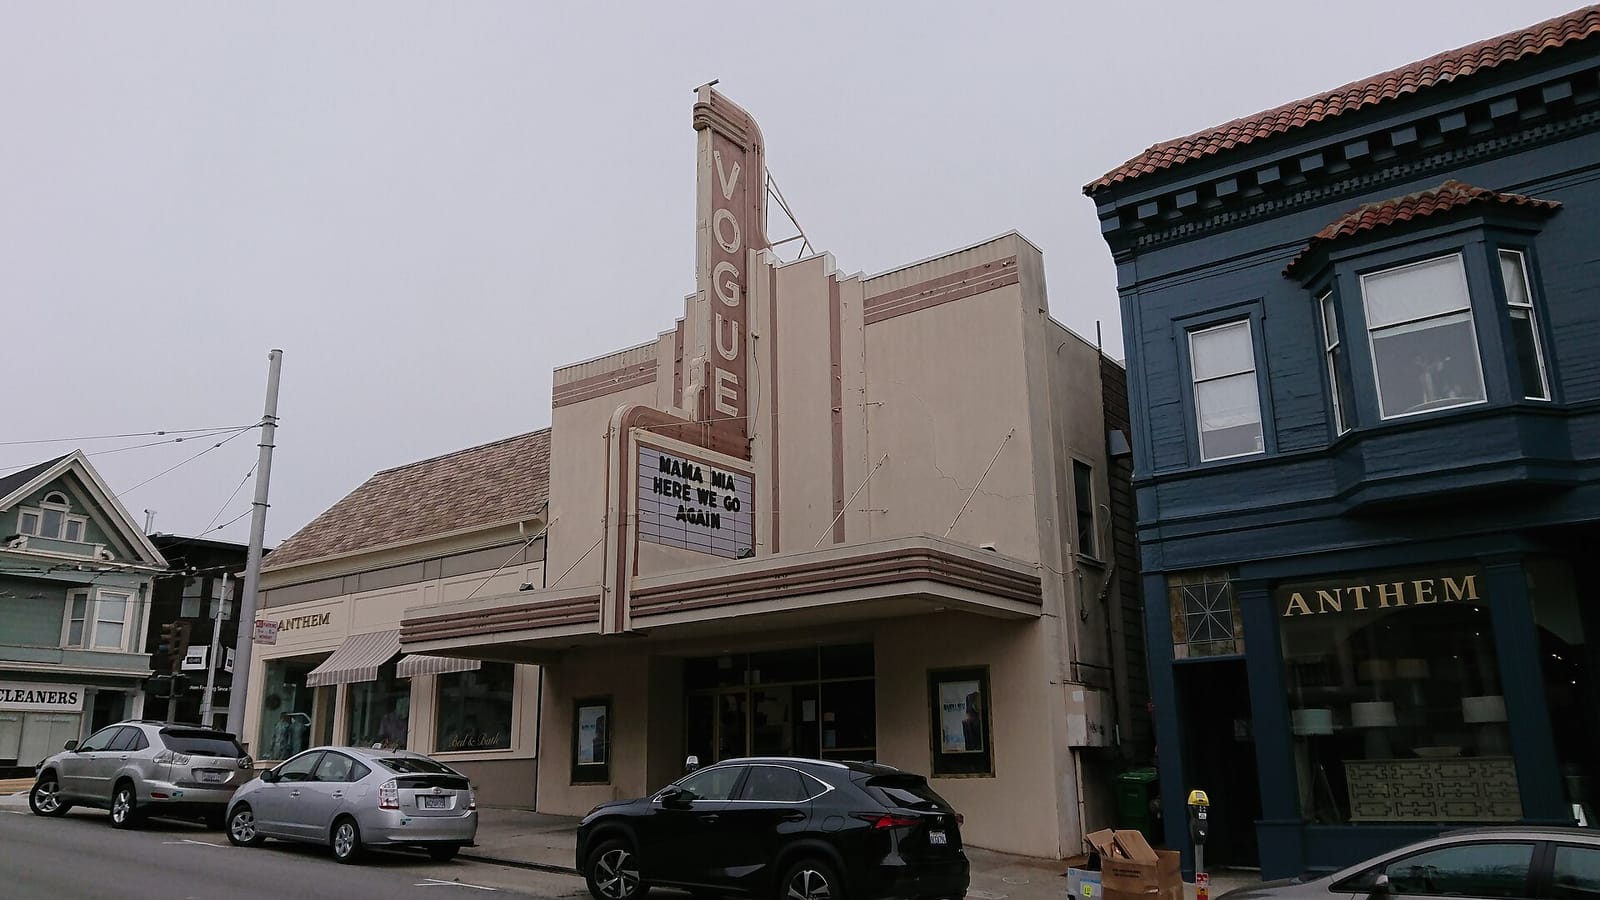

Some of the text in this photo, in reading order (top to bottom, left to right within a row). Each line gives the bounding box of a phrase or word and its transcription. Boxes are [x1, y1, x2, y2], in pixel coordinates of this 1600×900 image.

[713, 150, 741, 417] VOGUE
[659, 456, 735, 492] MAMA MIA
[653, 476, 741, 512] HERE WE GO
[676, 504, 720, 530] AGAIN
[1283, 575, 1480, 617] ANTHEM
[277, 612, 330, 632] ANTHEM
